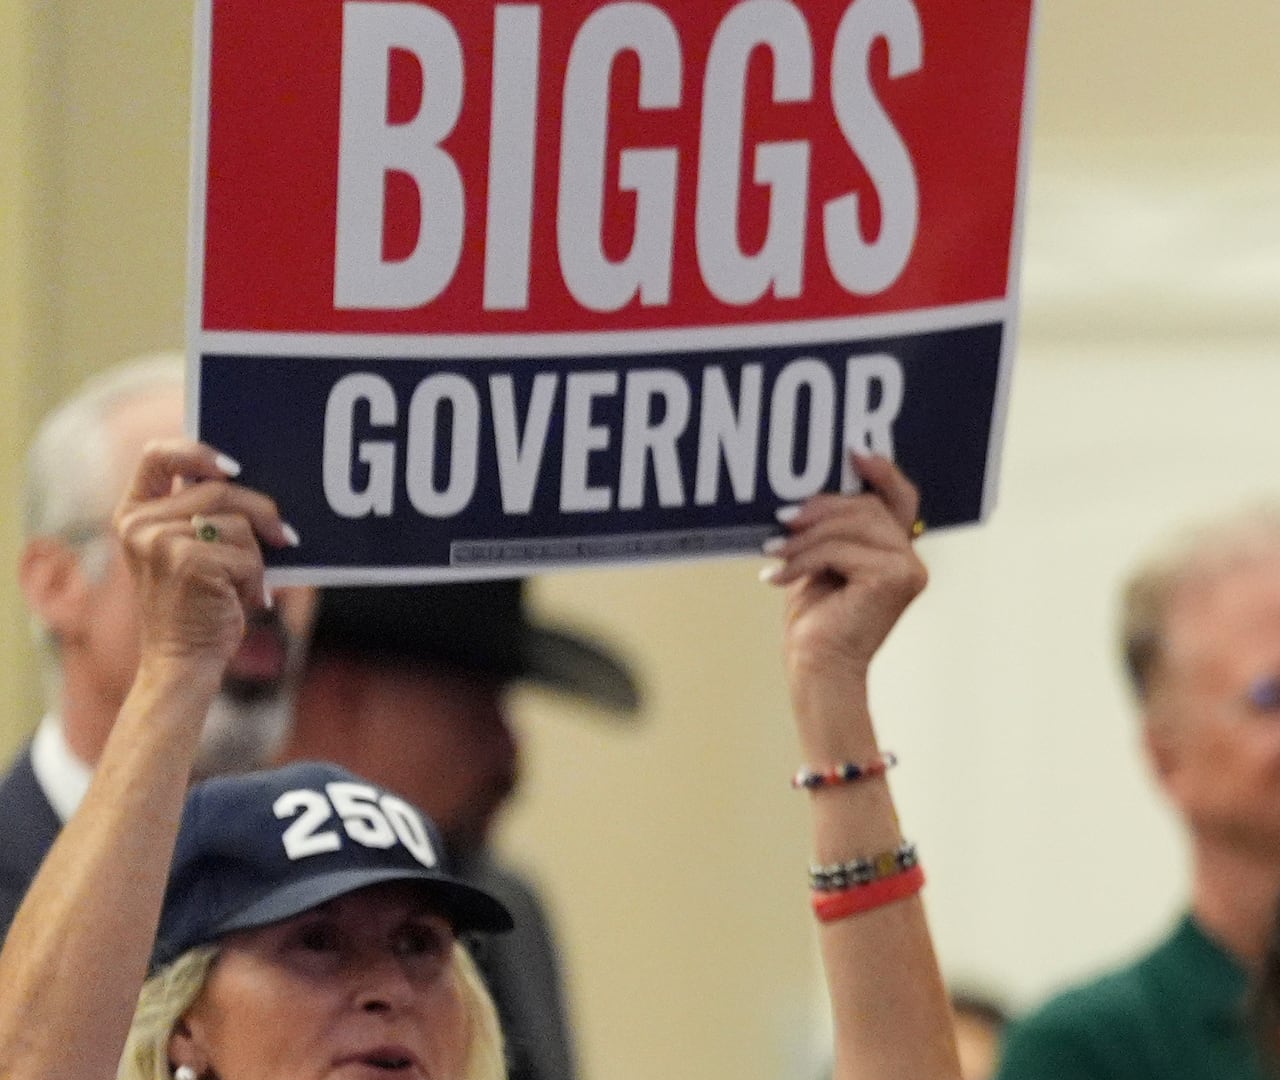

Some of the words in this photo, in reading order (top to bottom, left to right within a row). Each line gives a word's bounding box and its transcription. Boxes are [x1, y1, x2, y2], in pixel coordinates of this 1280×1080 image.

[333, 0, 924, 312] BIGGS
[322, 353, 904, 518] GOVERNOR
[272, 781, 437, 869] 250
